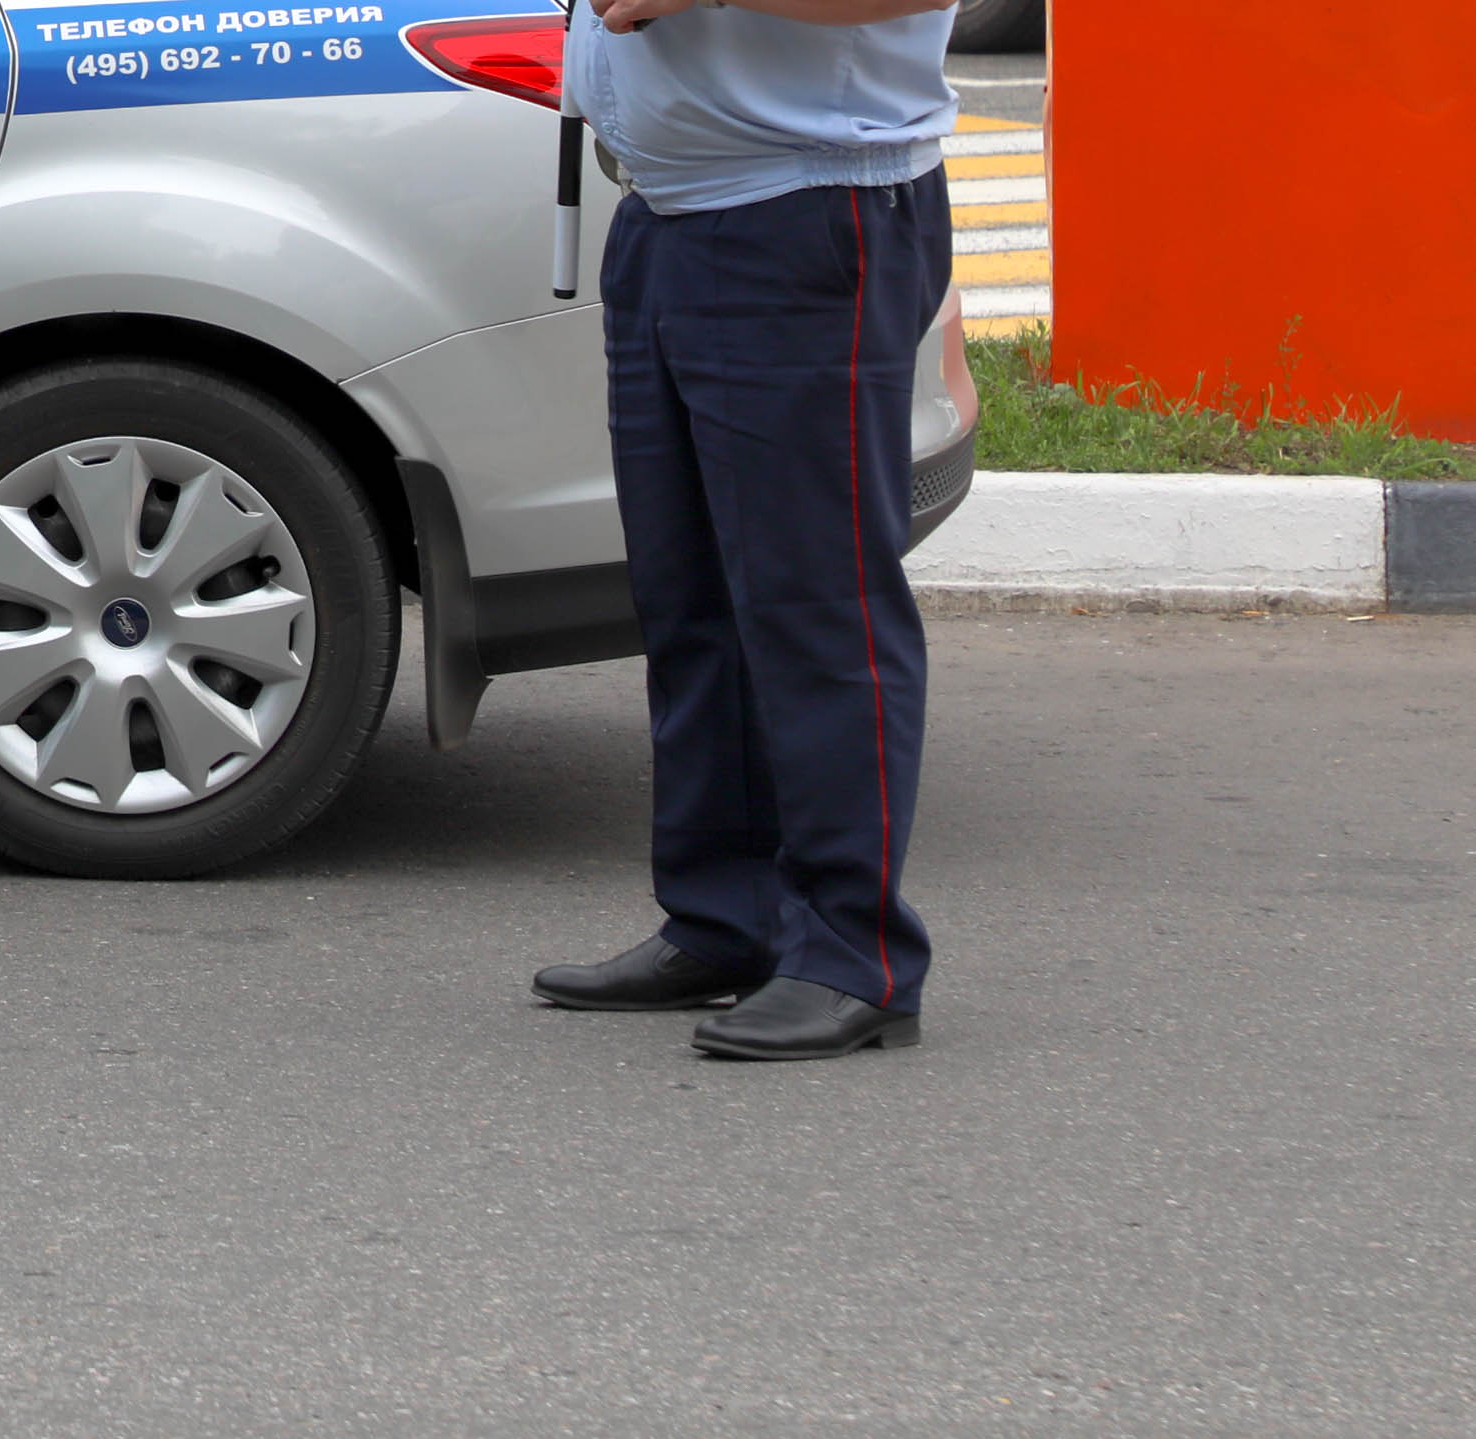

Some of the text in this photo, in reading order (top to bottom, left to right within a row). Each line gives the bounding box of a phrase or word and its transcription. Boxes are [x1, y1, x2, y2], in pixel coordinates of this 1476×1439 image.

[36, 5, 384, 42] ТЕЛЕФОН ДОВЕРИЯ
[66, 50, 149, 85] (495)
[160, 45, 221, 72] 692
[251, 41, 292, 65] 70
[322, 37, 363, 61] 66
